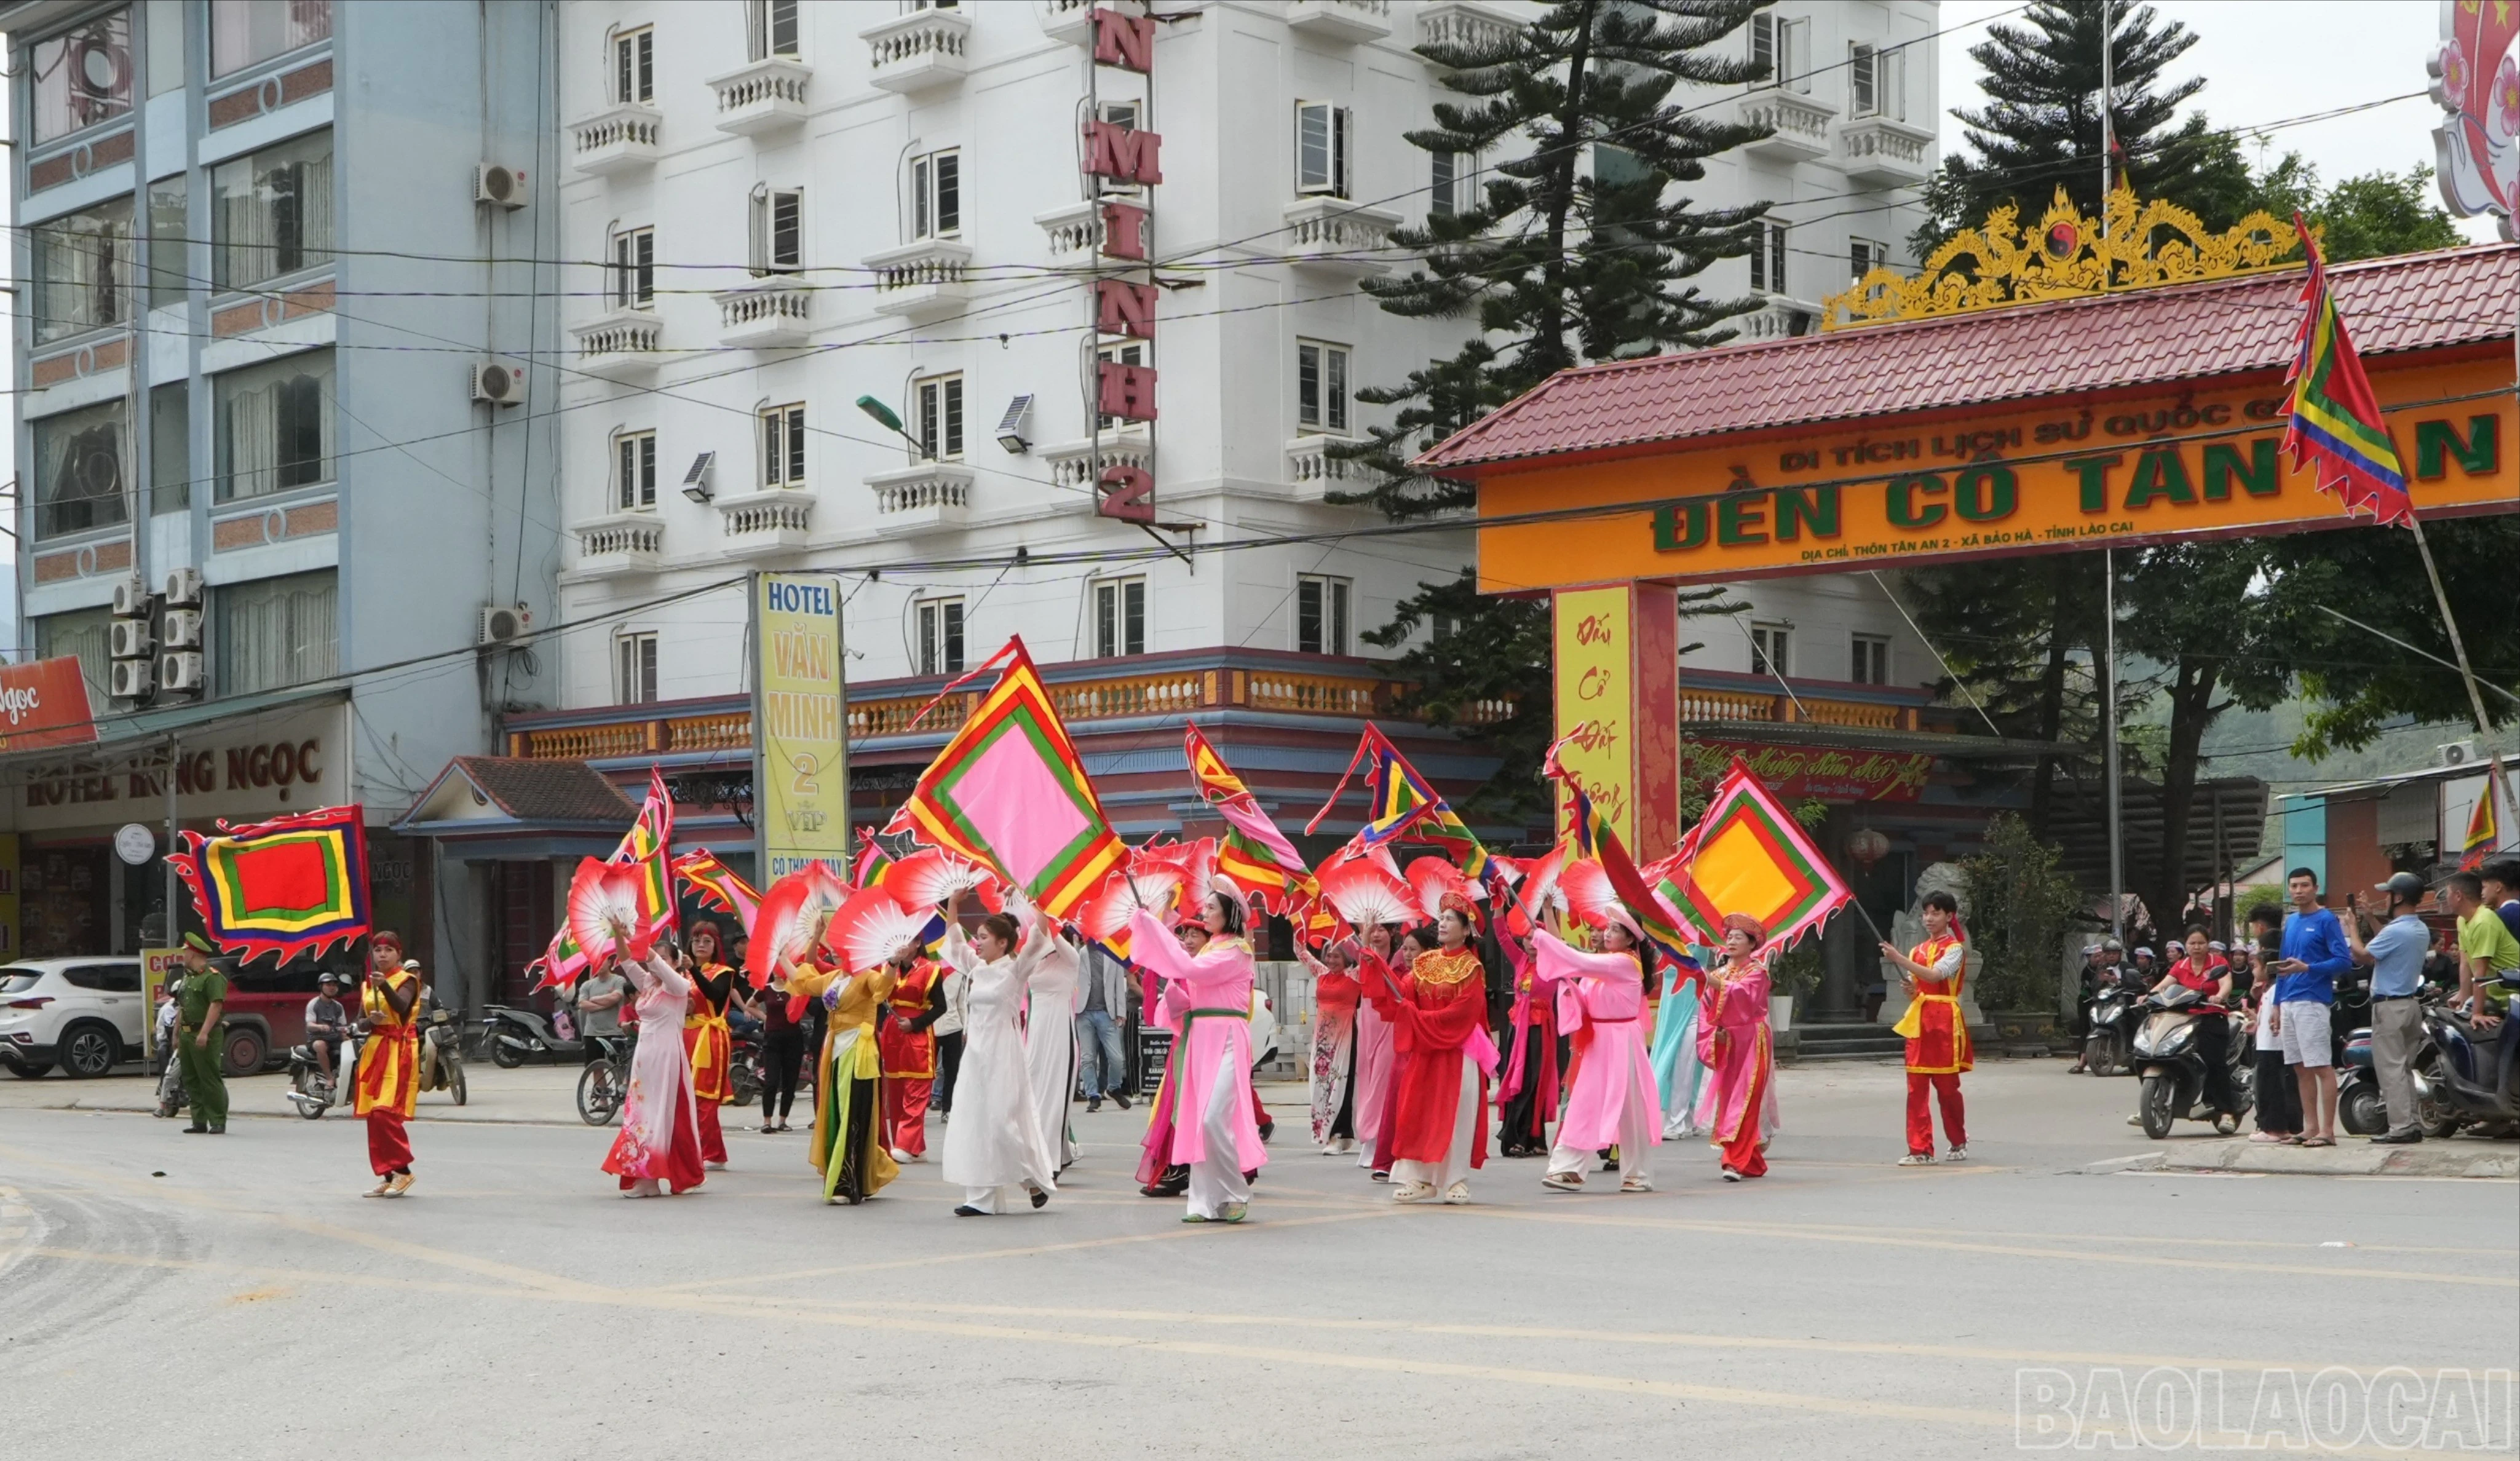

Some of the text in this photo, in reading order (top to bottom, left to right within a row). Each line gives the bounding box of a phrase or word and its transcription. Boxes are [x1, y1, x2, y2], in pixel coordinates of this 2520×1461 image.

[1082, 120, 1162, 421] MINH
[1780, 448, 1820, 472] DI
[1828, 437, 1920, 467] TÍCH
[1931, 424, 2022, 459] LỊCH
[2034, 408, 2094, 444] SỬ
[2104, 389, 2232, 435] QUỐC
[1649, 465, 1842, 553] ĐỀN
[2062, 434, 2281, 513] TÂN
[2387, 413, 2500, 483] N
[1853, 542, 1887, 556] THÔN
[1891, 540, 1917, 553] TÂN
[1920, 539, 1938, 550] AN
[1942, 538, 1950, 548] 2
[1961, 533, 1979, 547] XÃ
[1983, 529, 2011, 545] BẢO
[2015, 528, 2033, 542] HÀ
[2045, 525, 2076, 539] TỈNH
[2079, 522, 2107, 536] LÀO
[2110, 521, 2134, 533] CAI
[767, 582, 834, 616] HOTEL
[772, 622, 830, 681] VĂN
[768, 691, 839, 742] MINH
[226, 738, 323, 802] NGỌC
[792, 751, 819, 795] 2
[787, 810, 826, 832] VIP
[773, 853, 785, 876] CÓ
